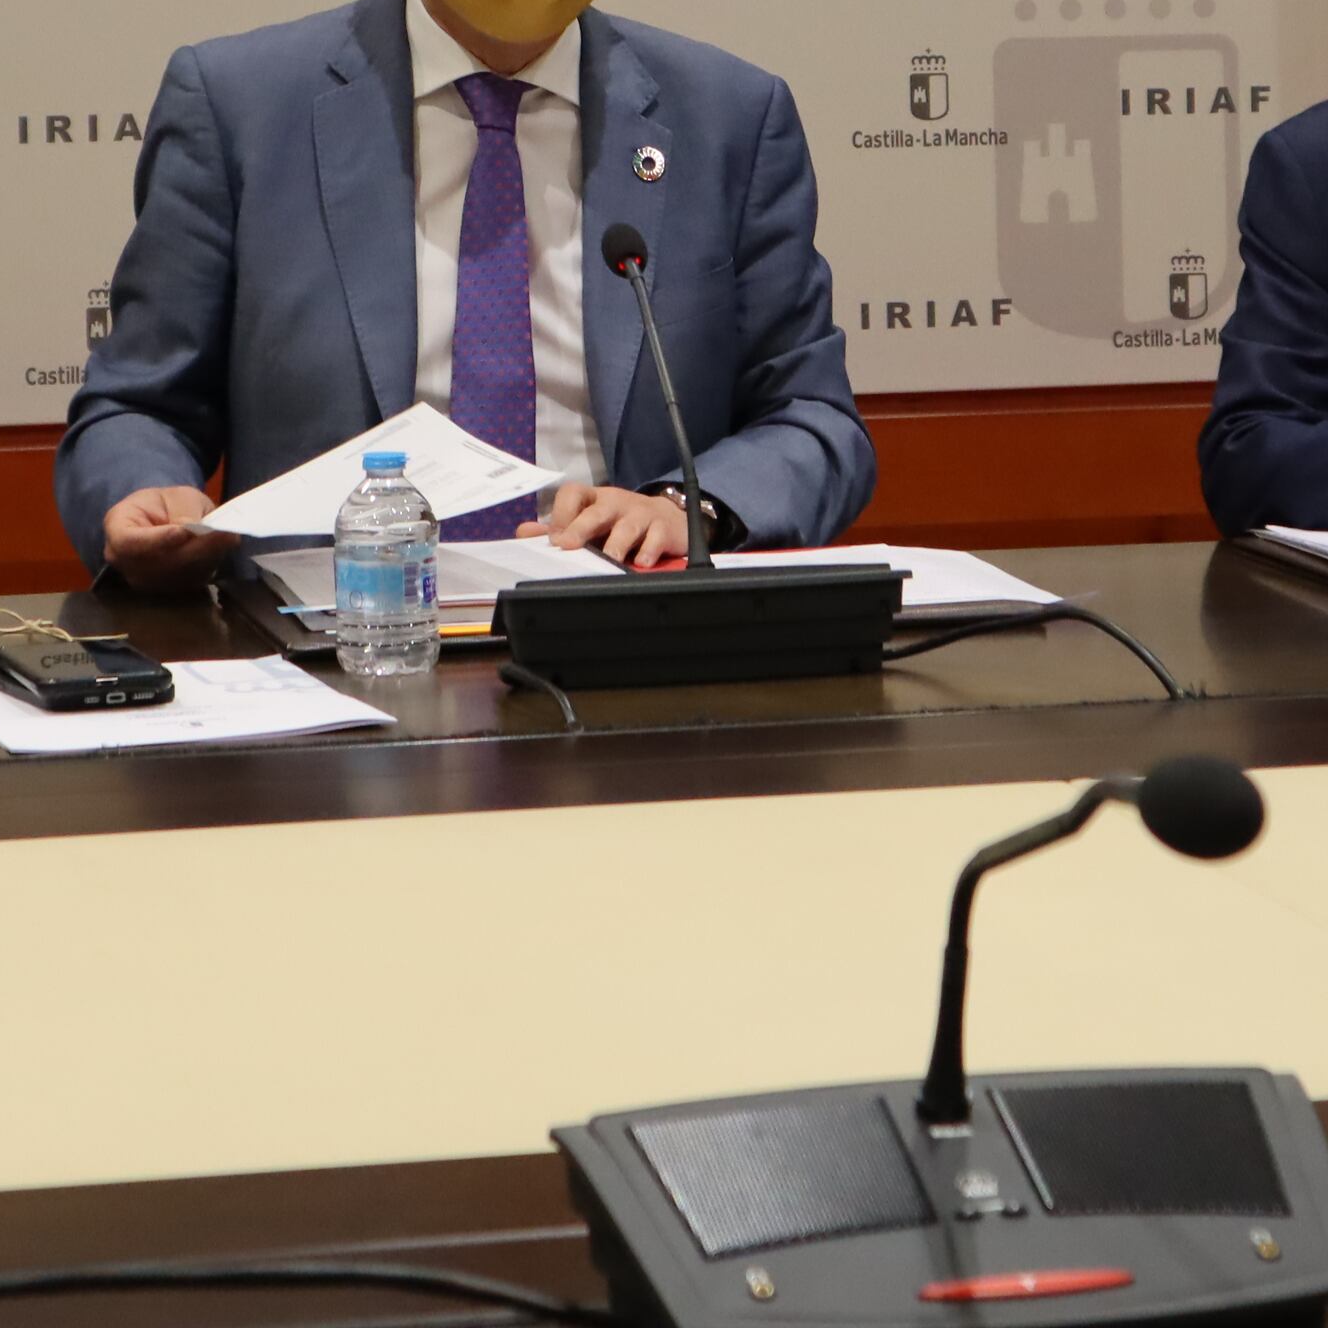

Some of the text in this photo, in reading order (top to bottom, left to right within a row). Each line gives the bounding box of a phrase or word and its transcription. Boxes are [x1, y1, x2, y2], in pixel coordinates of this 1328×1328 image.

[1122, 86, 1270, 115] IRIAF
[18, 114, 143, 143] IRIA
[852, 128, 1008, 148] Castilla-La Mancha
[861, 298, 1012, 330] IRIAF
[1112, 328, 1201, 348] Castilla-La
[25, 366, 87, 386] Castilla
